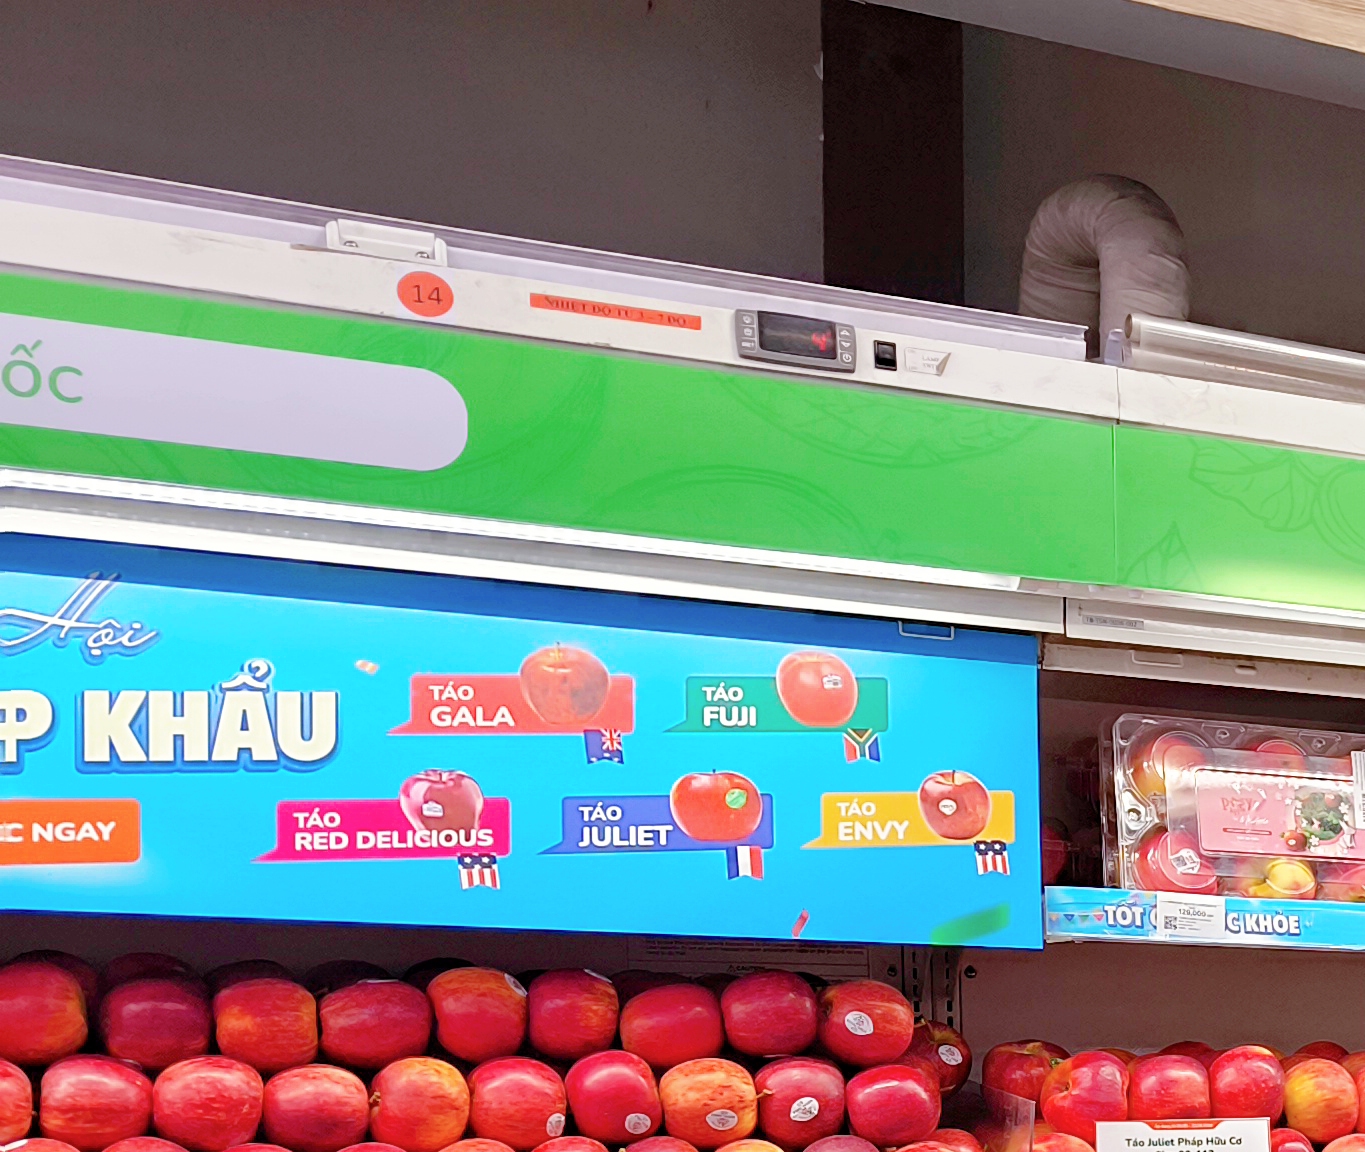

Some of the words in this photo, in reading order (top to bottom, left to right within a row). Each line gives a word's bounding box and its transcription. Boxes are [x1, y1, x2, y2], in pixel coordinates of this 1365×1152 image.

[411, 285, 443, 305] 14
[428, 681, 474, 701] TÁO
[702, 682, 744, 702] TÁO
[429, 705, 515, 728] GALA
[702, 706, 757, 728] FUJI
[293, 807, 341, 828] TÁO
[578, 800, 622, 822] TÁO
[836, 800, 877, 817] TÁO
[32, 821, 116, 842] NGAY
[294, 831, 349, 851] RED
[356, 828, 494, 849] DELICIOUS
[578, 824, 673, 848] JULIET
[837, 820, 909, 842] ENVY
[1244, 910, 1301, 935] KHỎE
[1125, 1137, 1145, 1147] Táo
[1148, 1137, 1175, 1147] Juliet
[1178, 1137, 1203, 1151] Pháp
[1206, 1136, 1227, 1146] Hữu
[1229, 1137, 1242, 1145] Cơ
